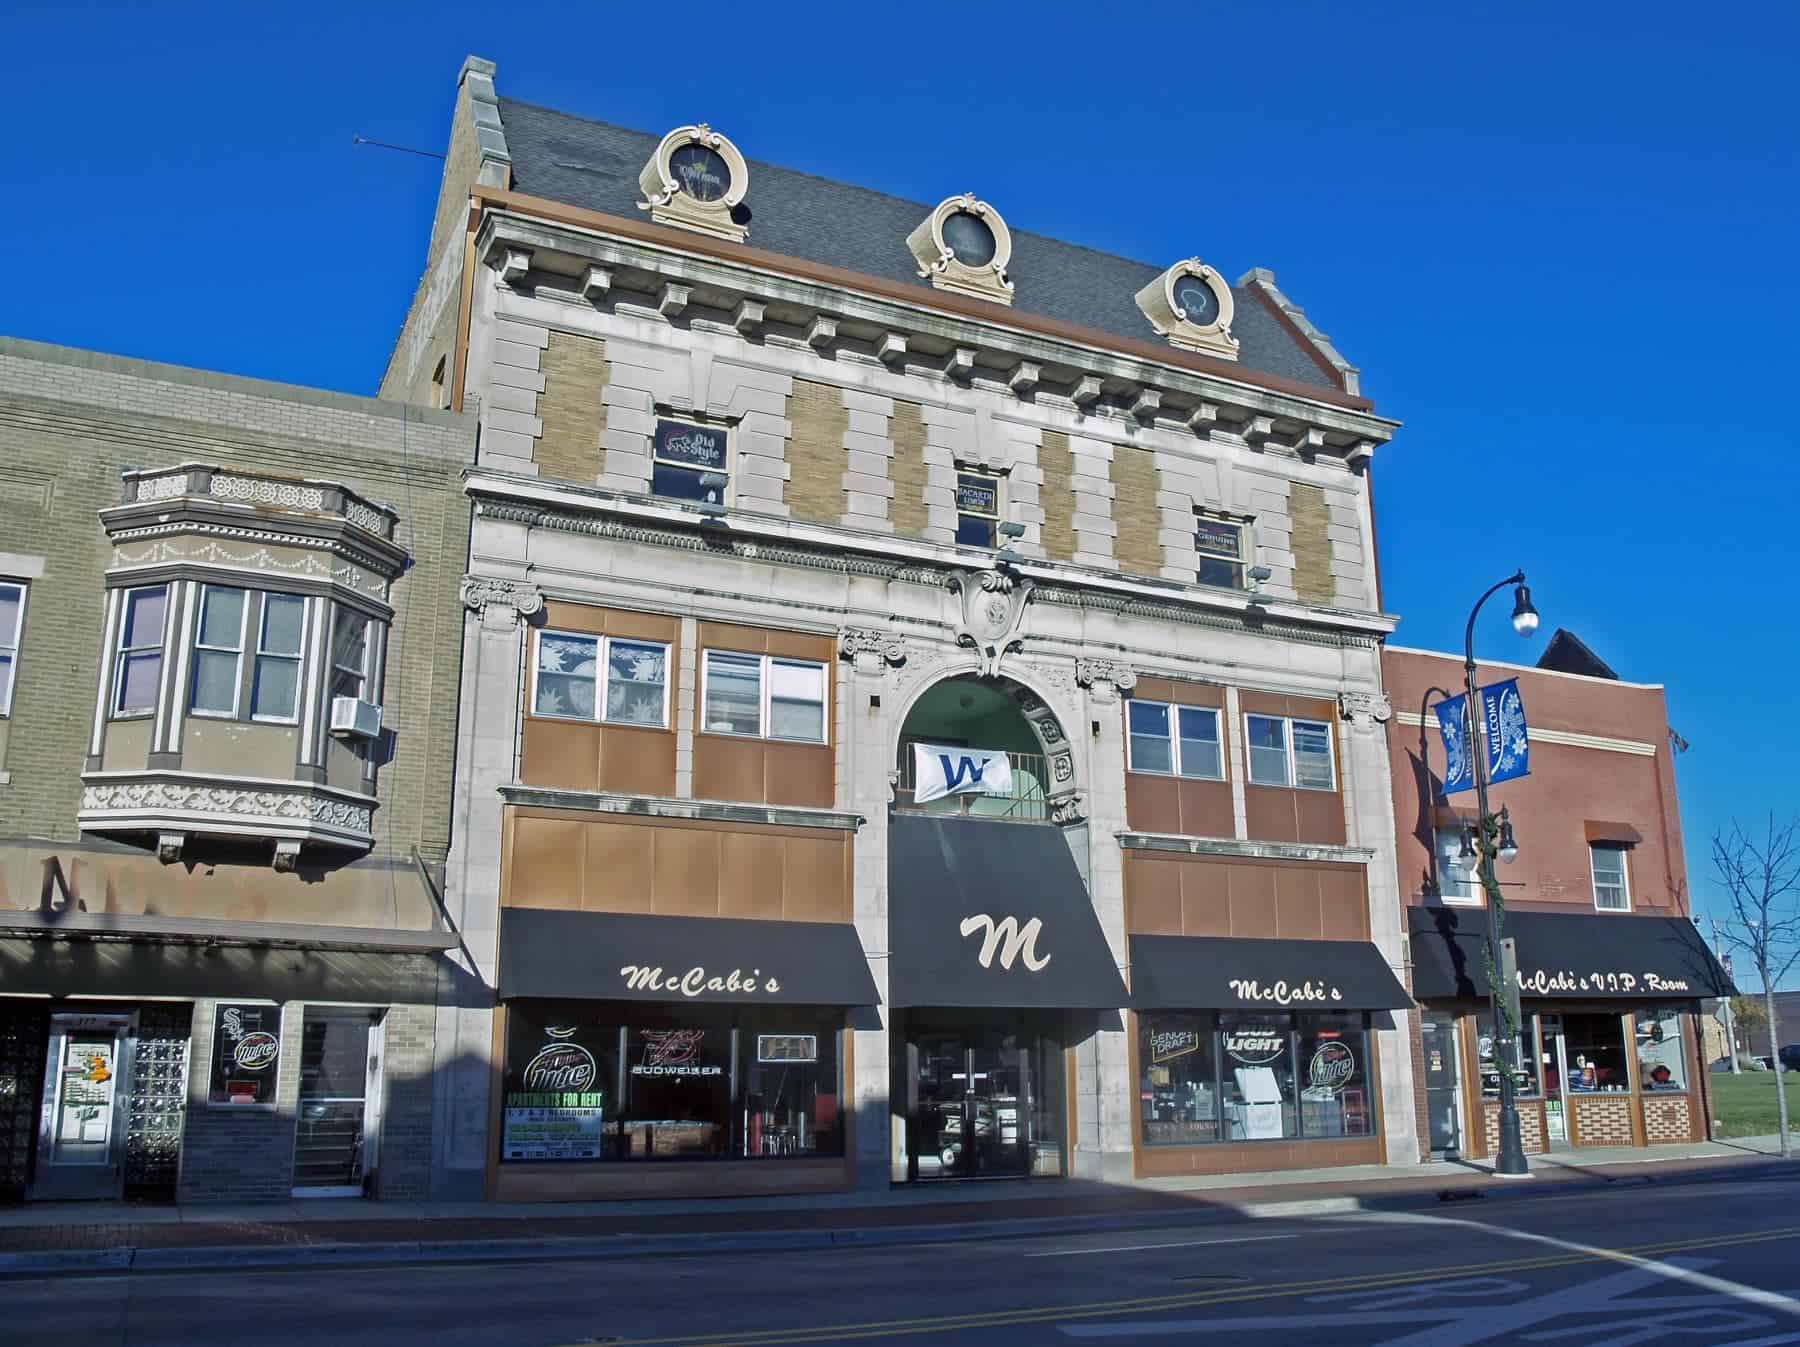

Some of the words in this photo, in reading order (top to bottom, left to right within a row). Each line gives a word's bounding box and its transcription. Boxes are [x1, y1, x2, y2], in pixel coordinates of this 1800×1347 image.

[695, 433, 715, 448] Old
[690, 443, 720, 461] Style
[1487, 695, 1501, 755] WELCOME
[939, 754, 991, 791] W
[620, 966, 780, 997] McCabe's
[1643, 973, 1689, 991] Room
[1229, 979, 1343, 1005] McCabe's
[1157, 1032, 1193, 1056] DRAFT
[1226, 1038, 1284, 1051] LIGHT
[632, 1066, 721, 1075] BUDWEISER
[563, 1092, 578, 1107] FOR
[581, 1092, 602, 1107] RENT
